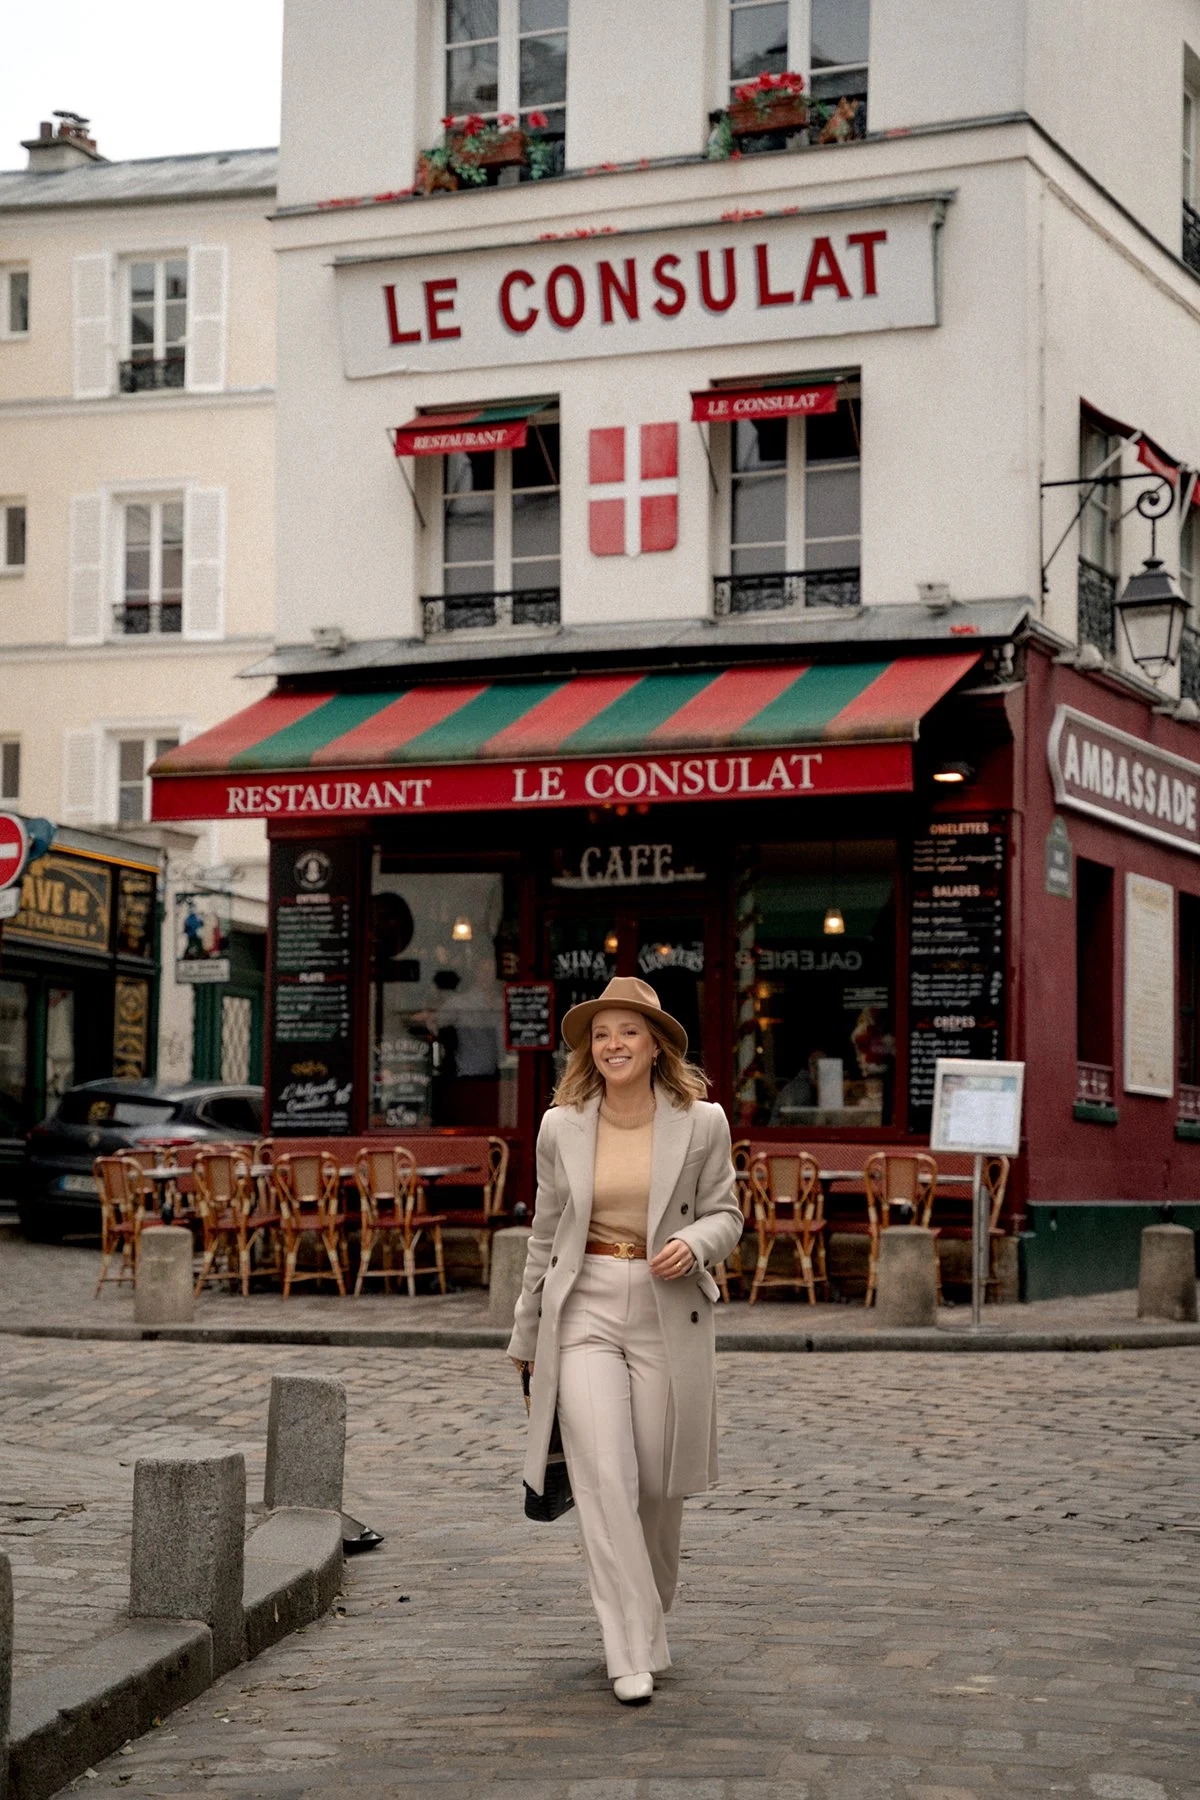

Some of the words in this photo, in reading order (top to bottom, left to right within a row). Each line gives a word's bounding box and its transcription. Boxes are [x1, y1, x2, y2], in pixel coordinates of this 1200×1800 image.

[383, 279, 462, 344] LE
[499, 229, 888, 333] CONSULAT
[707, 400, 729, 415] LE
[733, 391, 819, 412] CONSULAT
[413, 429, 507, 450] RESTAURANT
[226, 779, 432, 814] RESTAURANT
[512, 766, 566, 802] LE
[584, 753, 823, 799] CONSULAT
[1063, 733, 1197, 832] AMBASSADE
[21, 874, 66, 916] AVE
[932, 884, 981, 898] SALADES
